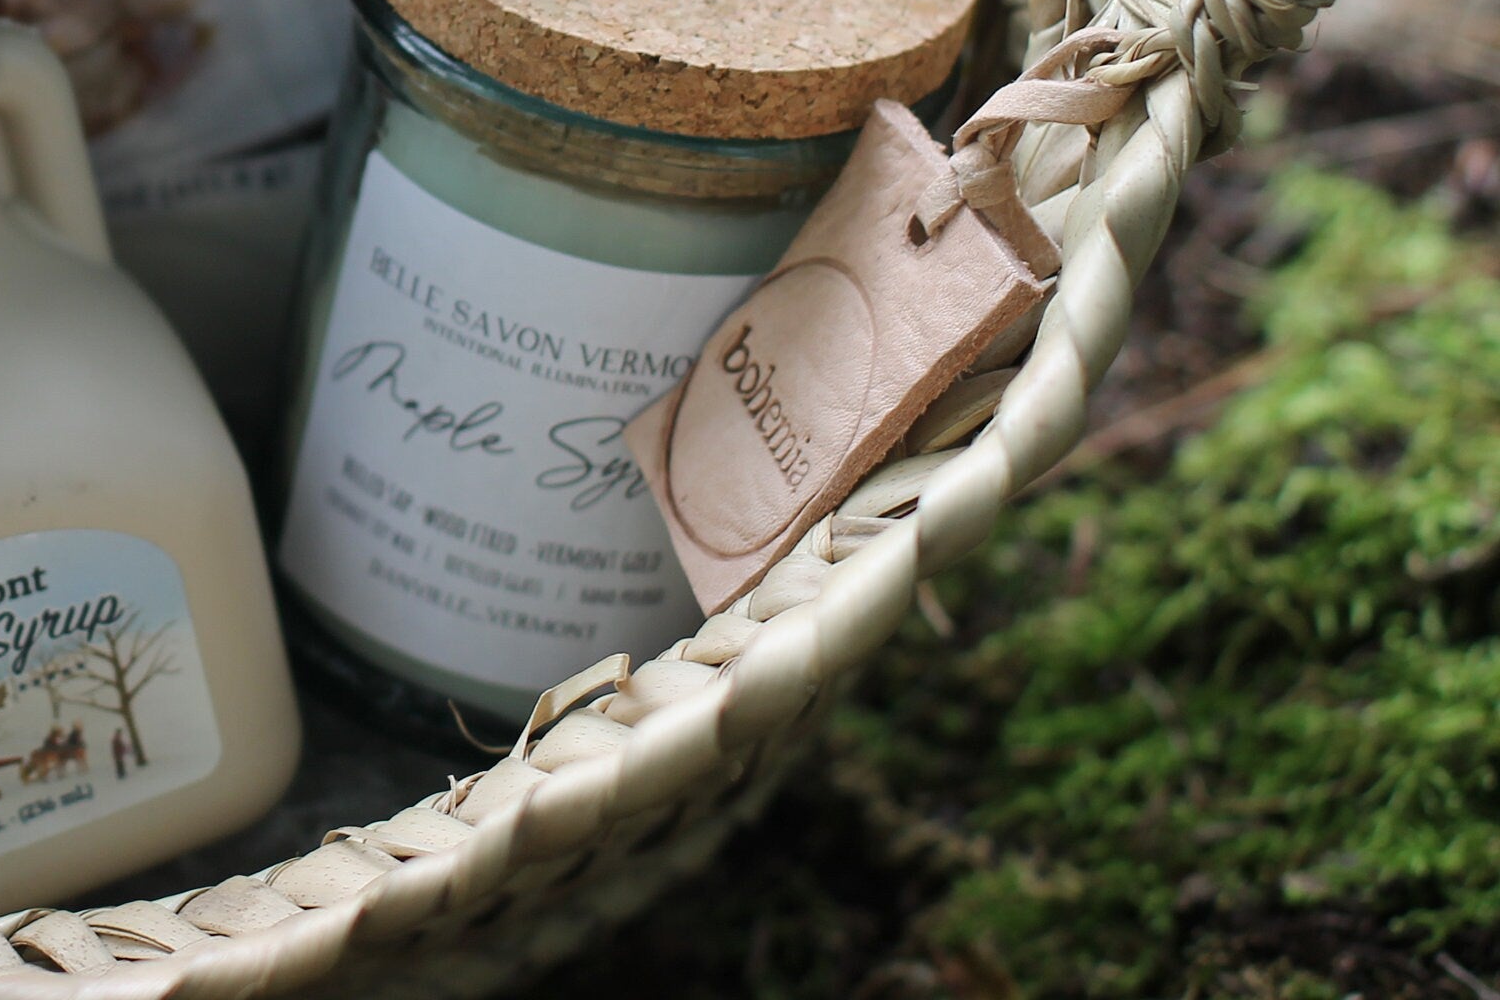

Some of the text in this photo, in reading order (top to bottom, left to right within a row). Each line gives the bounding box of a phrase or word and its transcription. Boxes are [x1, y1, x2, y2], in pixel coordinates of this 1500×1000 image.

[370, 247, 700, 379] BELLE SAVON VERMO
[424, 317, 650, 397] INTENTIONAL ILLUMINATION
[331, 341, 648, 512] Maple Syr
[722, 325, 811, 493] bohemia
